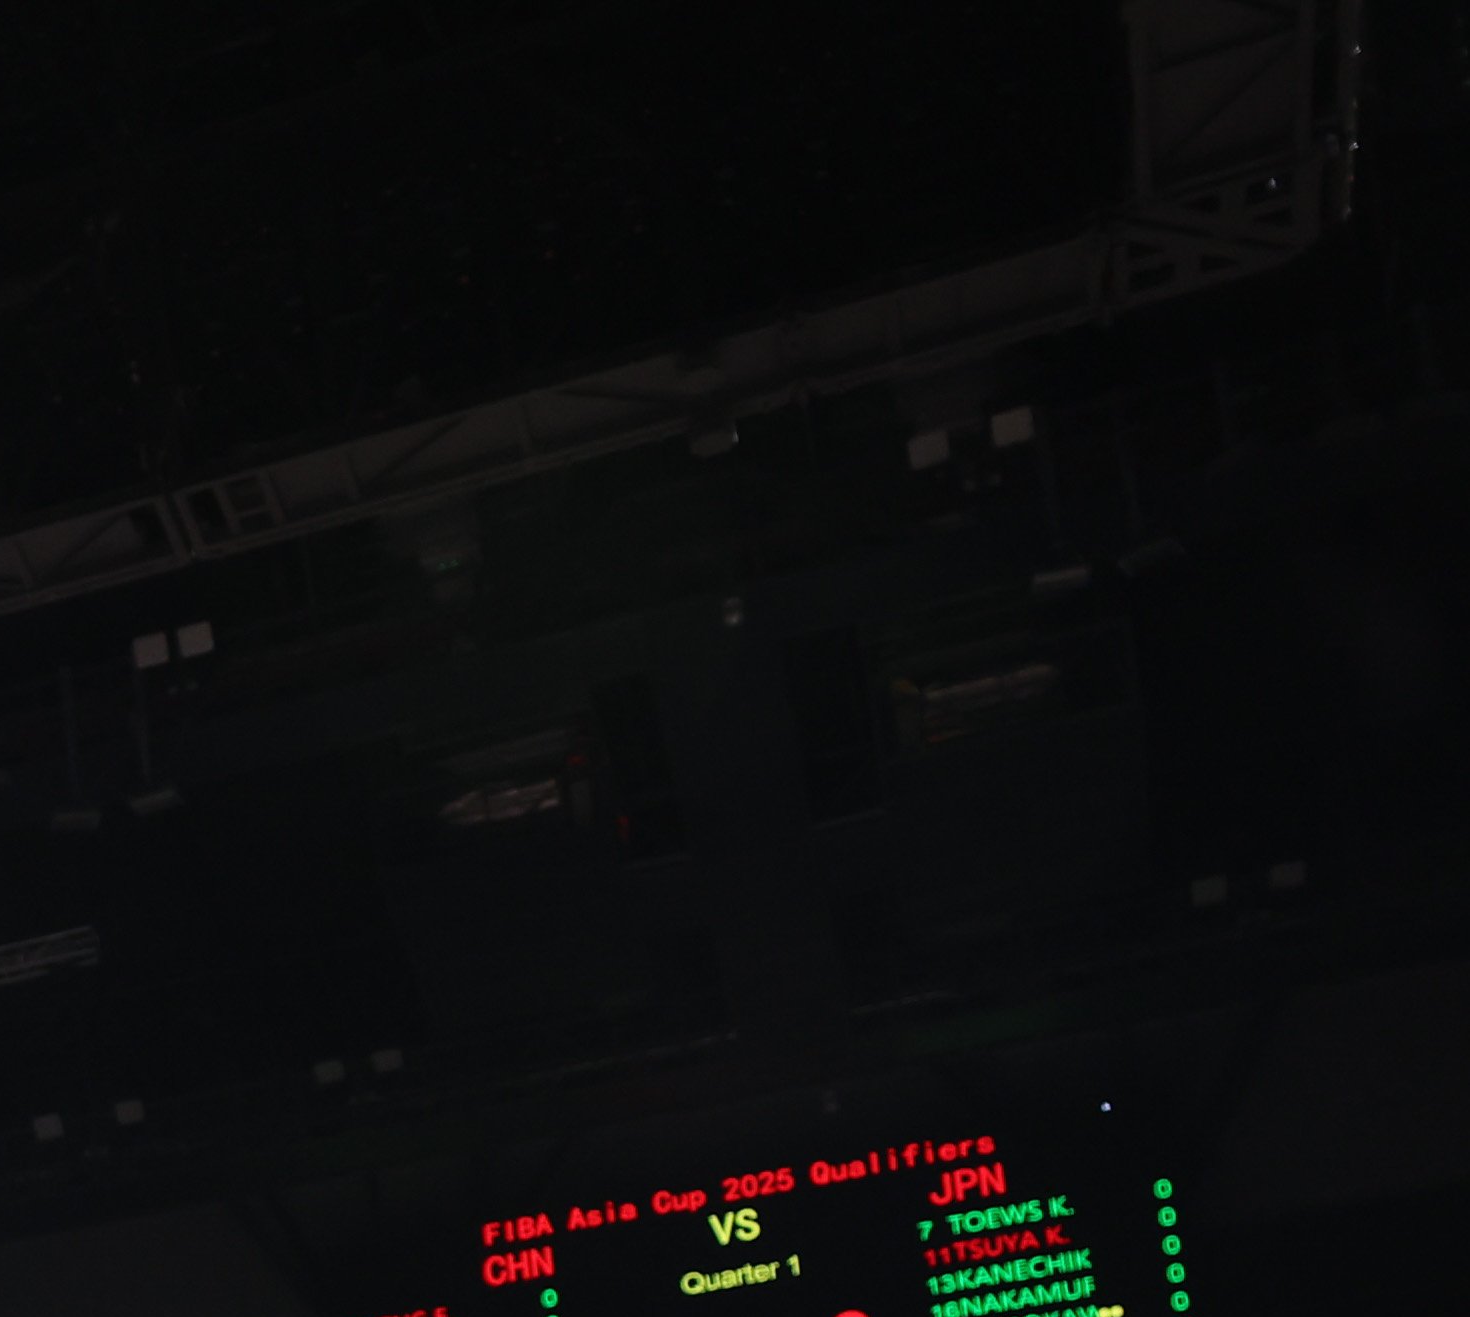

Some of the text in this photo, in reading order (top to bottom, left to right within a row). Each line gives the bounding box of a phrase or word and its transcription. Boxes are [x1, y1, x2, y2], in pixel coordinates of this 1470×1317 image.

[482, 1135, 996, 1247] FIBA Asia Cup 2025 Qualifiers
[927, 1162, 1007, 1207] JPN
[707, 1207, 762, 1246] VS
[917, 1178, 1173, 1241] 7 TOEWS K. 0
[1044, 1224, 1072, 1246] K.
[1157, 1206, 1177, 1227] 0
[481, 1246, 556, 1288] CHN
[680, 1254, 803, 1296] Quarter 1
[540, 1287, 559, 1309] 0
